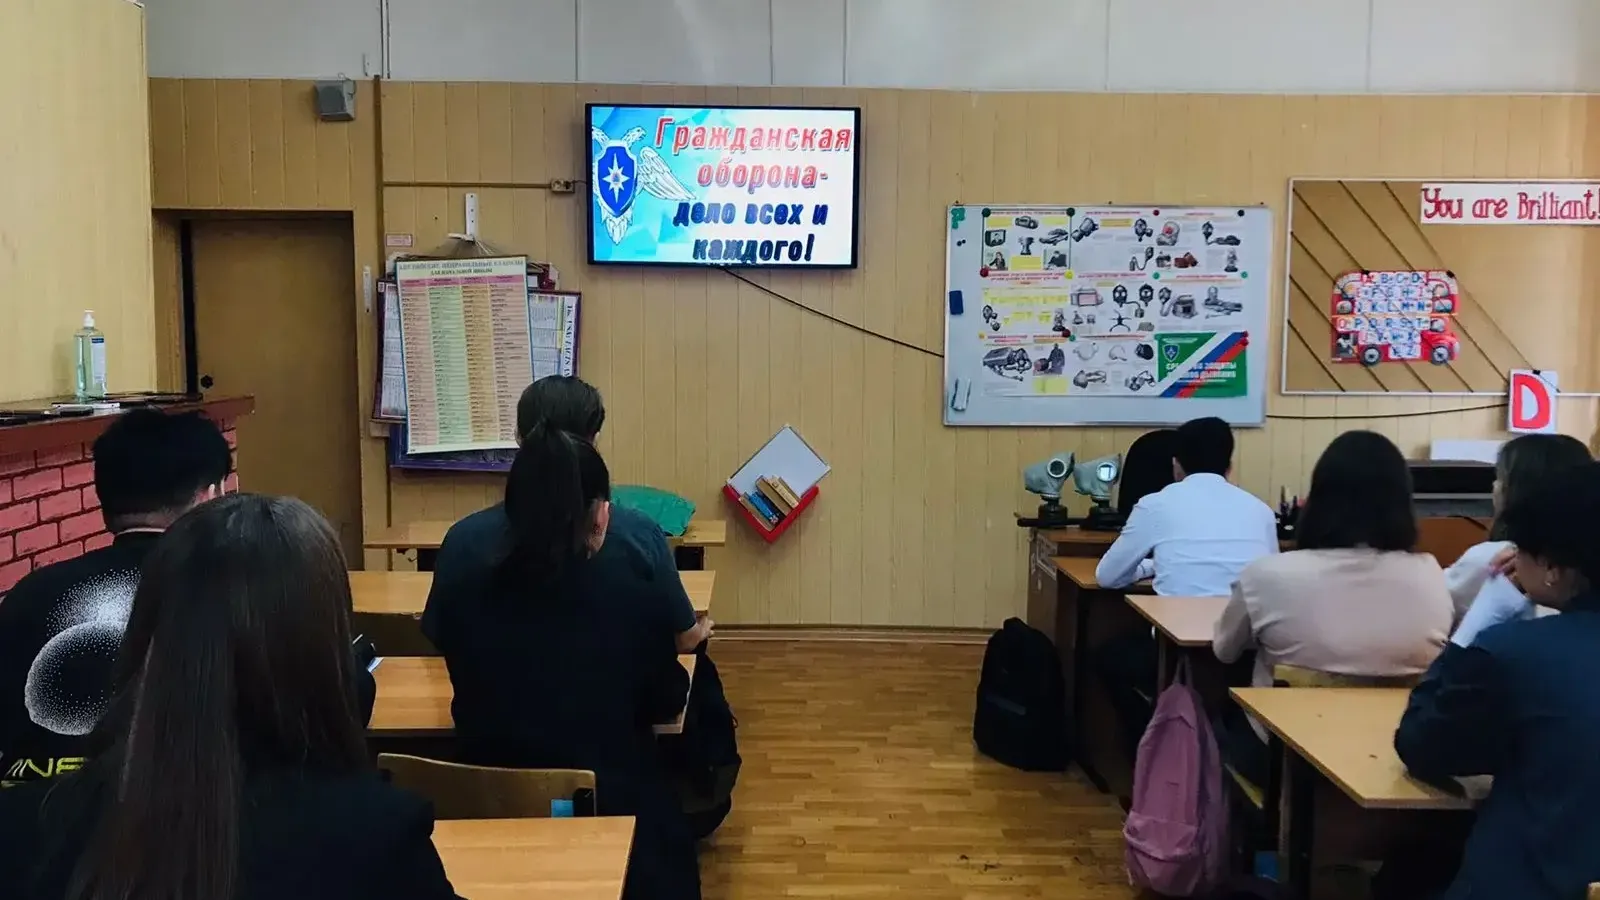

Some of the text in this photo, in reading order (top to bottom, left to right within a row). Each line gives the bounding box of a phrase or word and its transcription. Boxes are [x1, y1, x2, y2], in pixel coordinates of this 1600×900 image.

[655, 117, 852, 156] Гражданская
[697, 158, 829, 194] оборона-
[673, 201, 829, 227] дело всех и
[1421, 187, 1464, 219] You
[1472, 198, 1508, 219] are
[692, 233, 816, 262] каждого!
[1512, 372, 1552, 430] D
